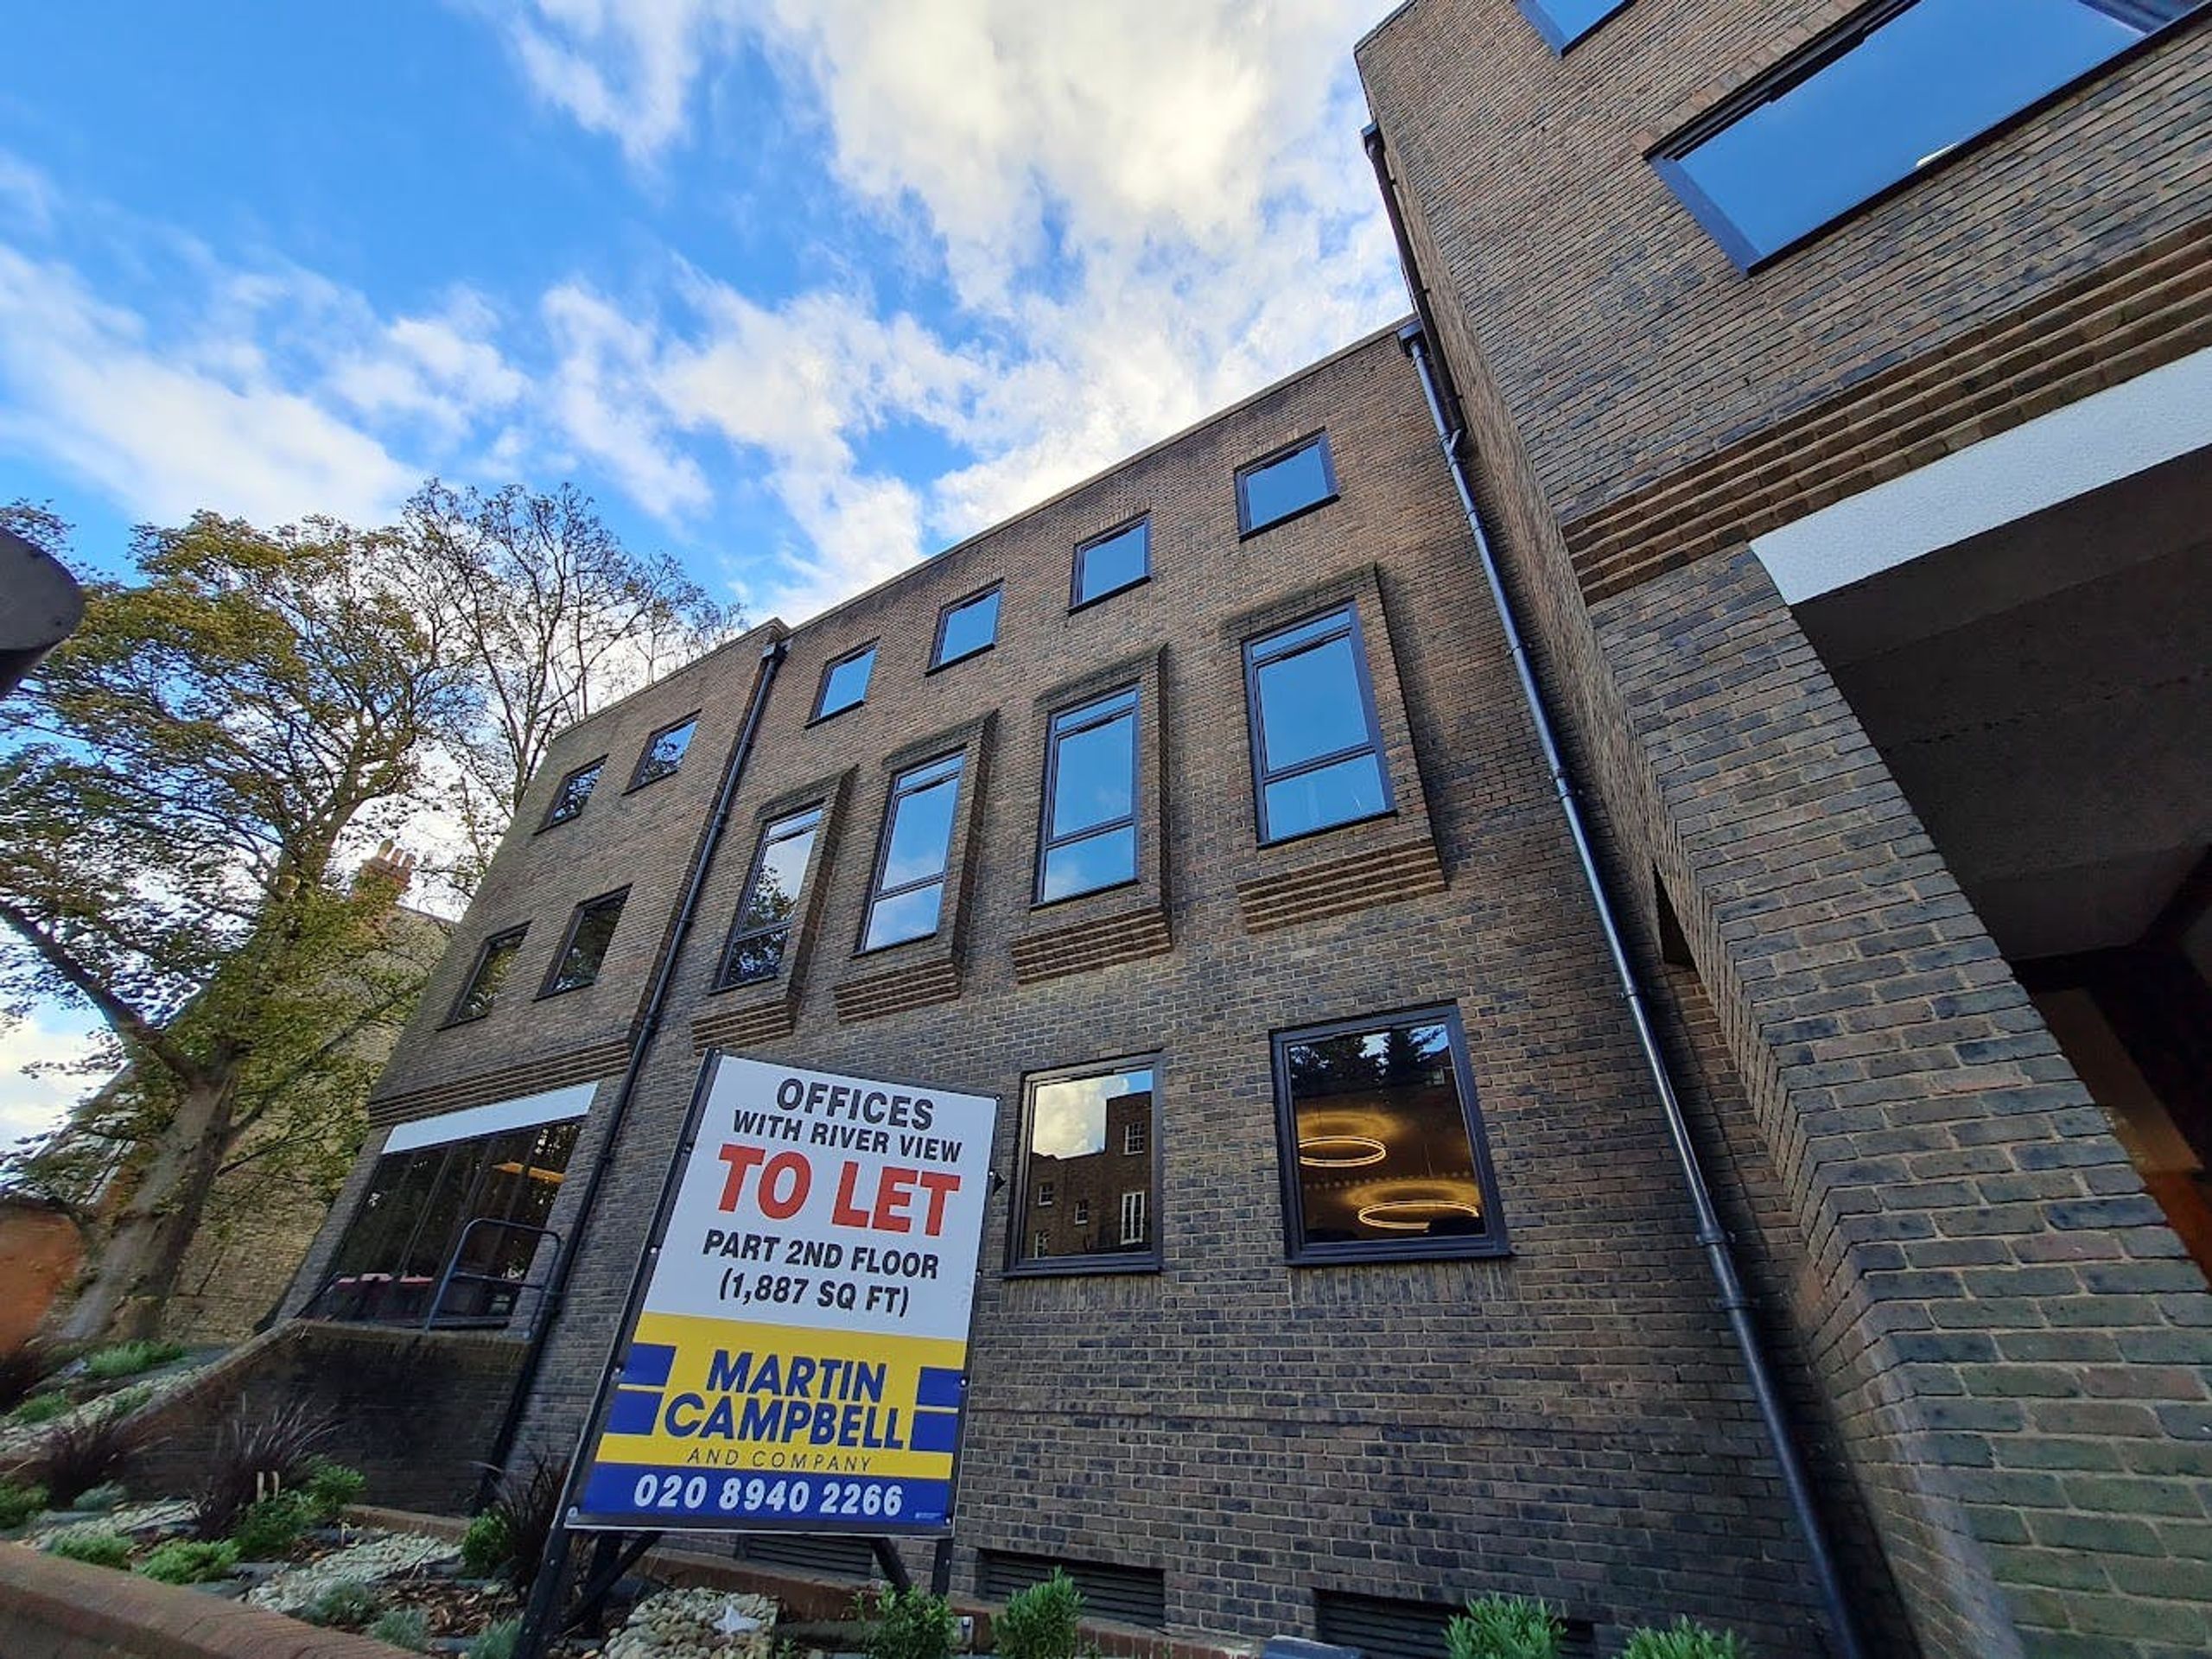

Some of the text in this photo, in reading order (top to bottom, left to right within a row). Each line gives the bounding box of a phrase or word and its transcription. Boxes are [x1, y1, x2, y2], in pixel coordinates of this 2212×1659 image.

[777, 1077, 934, 1130] OFFICES
[734, 1109, 963, 1162] WITH RIVER VIEW
[718, 1143, 961, 1236] TO LET
[702, 1230, 938, 1279] PART 2ND FLOOR
[719, 1268, 910, 1318] (1,887 SQ FT)
[706, 1349, 887, 1402] MARTIN
[664, 1394, 904, 1450] CAMPBELL
[687, 1448, 871, 1471] AND COMPANY
[633, 1474, 903, 1516] 020 8940 2266
